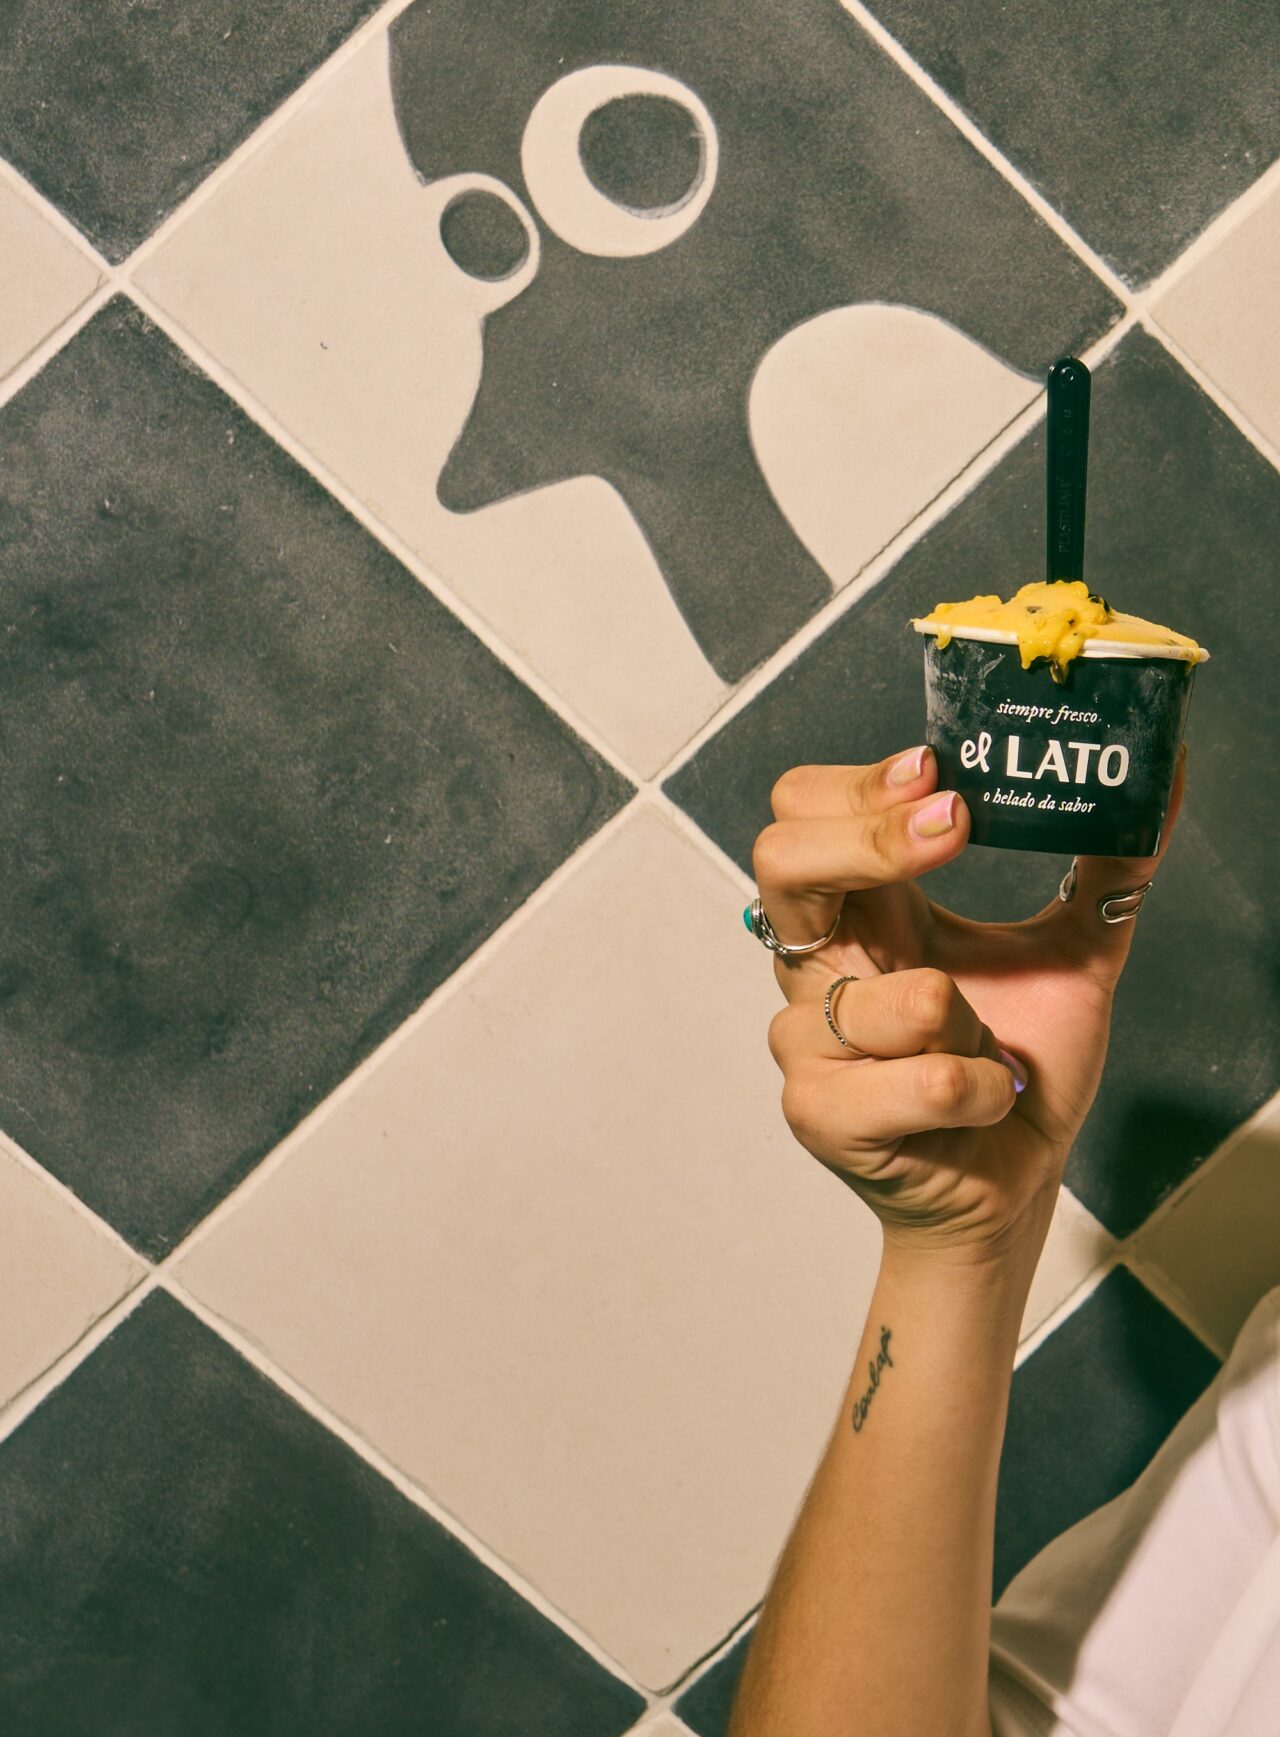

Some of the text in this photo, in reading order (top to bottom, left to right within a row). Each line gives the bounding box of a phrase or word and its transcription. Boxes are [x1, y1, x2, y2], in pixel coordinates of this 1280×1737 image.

[996, 698, 1099, 725] siempre fresco
[960, 731, 1130, 787] el LATO
[983, 788, 1097, 813] o helado da sabor
